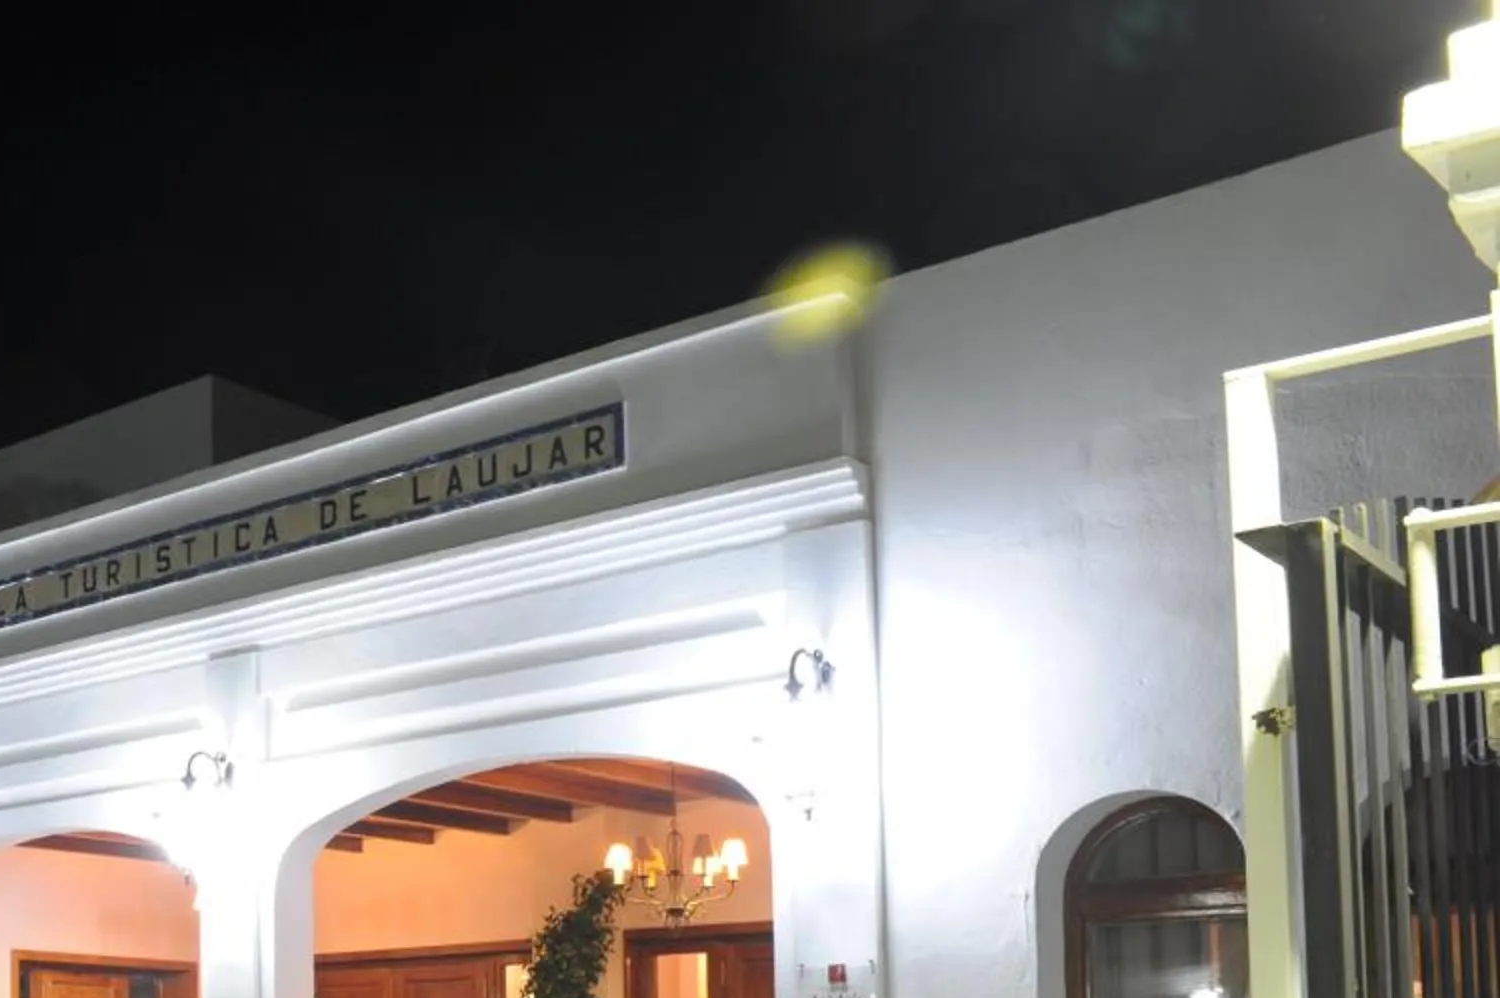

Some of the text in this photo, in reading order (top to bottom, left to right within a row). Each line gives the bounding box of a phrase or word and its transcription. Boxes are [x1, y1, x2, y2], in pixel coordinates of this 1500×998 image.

[58, 514, 279, 599] TURISTICA
[319, 490, 367, 531] DE
[411, 424, 606, 506] LAUJAR
